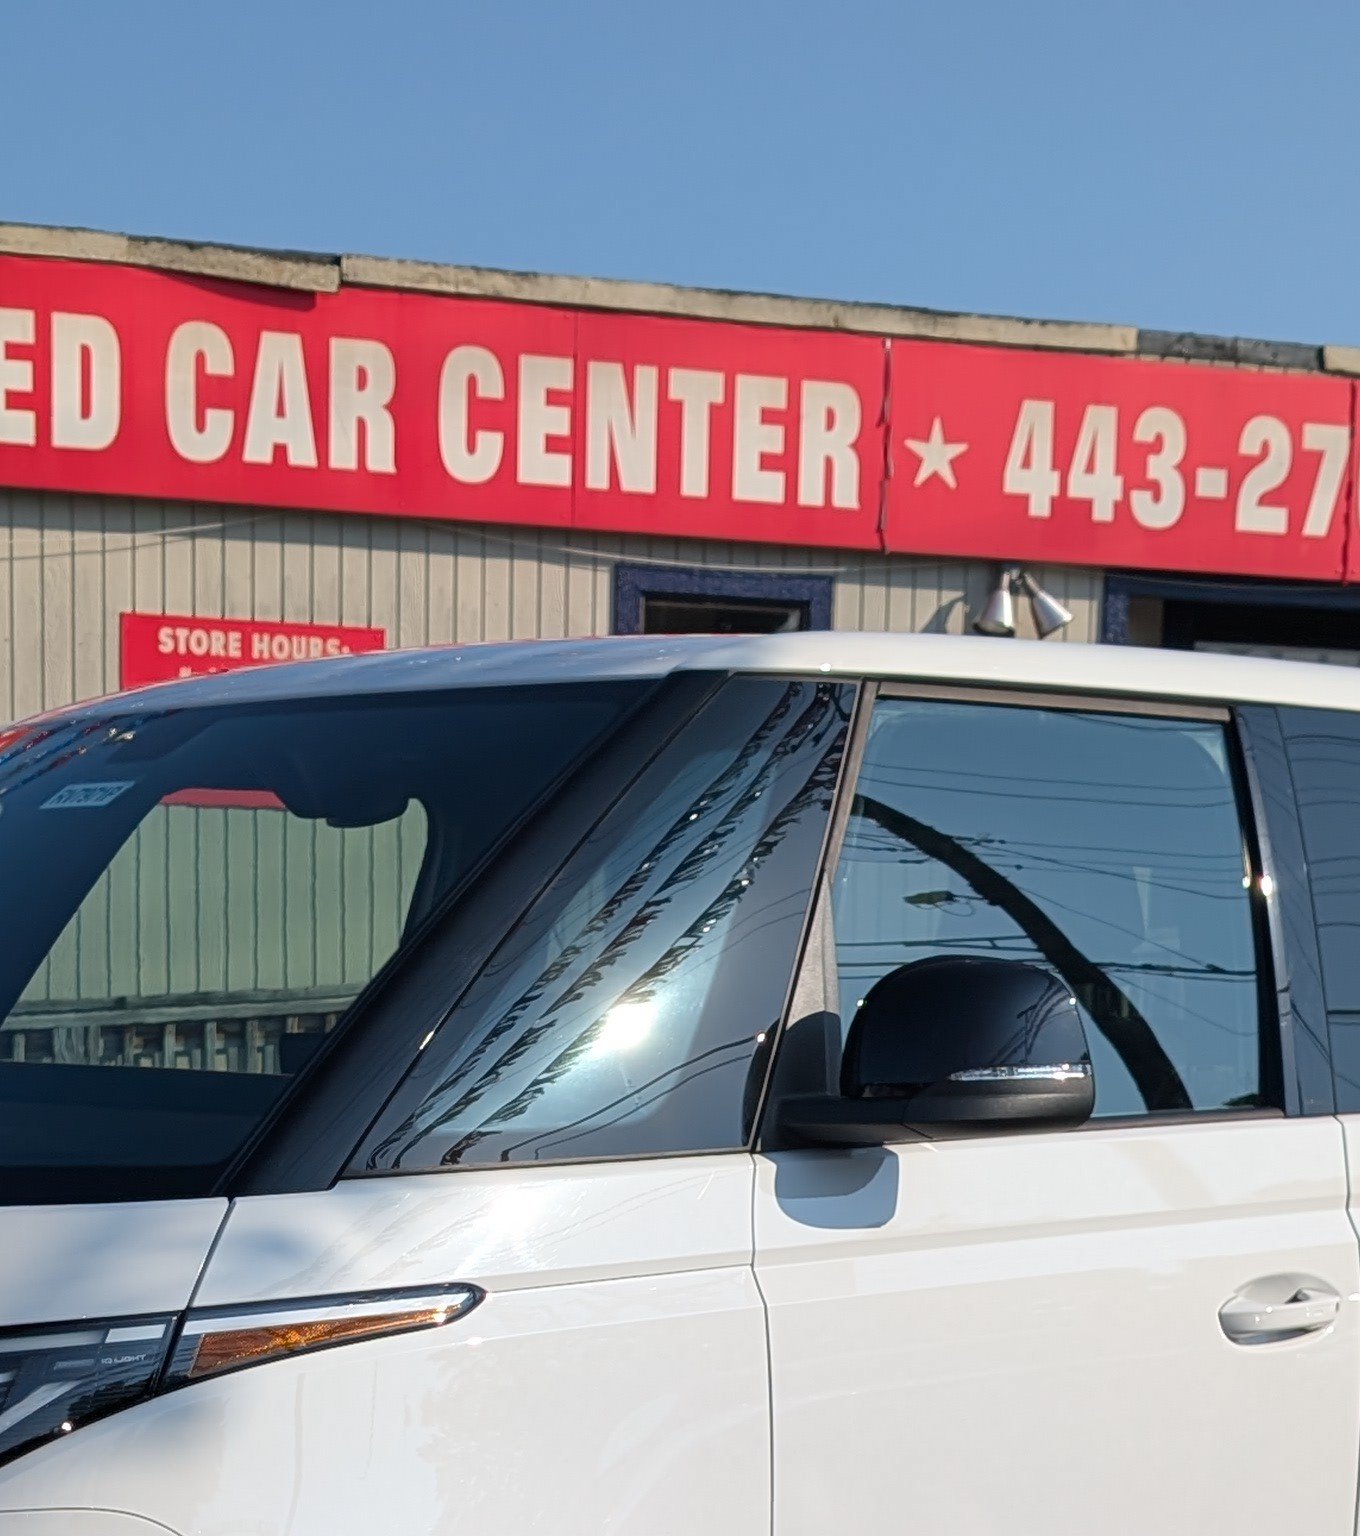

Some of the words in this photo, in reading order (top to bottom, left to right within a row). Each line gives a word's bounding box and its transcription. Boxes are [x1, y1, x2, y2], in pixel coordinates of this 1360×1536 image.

[164, 319, 398, 475] CAR
[437, 344, 863, 511] CENTER
[157, 626, 243, 659] STORE
